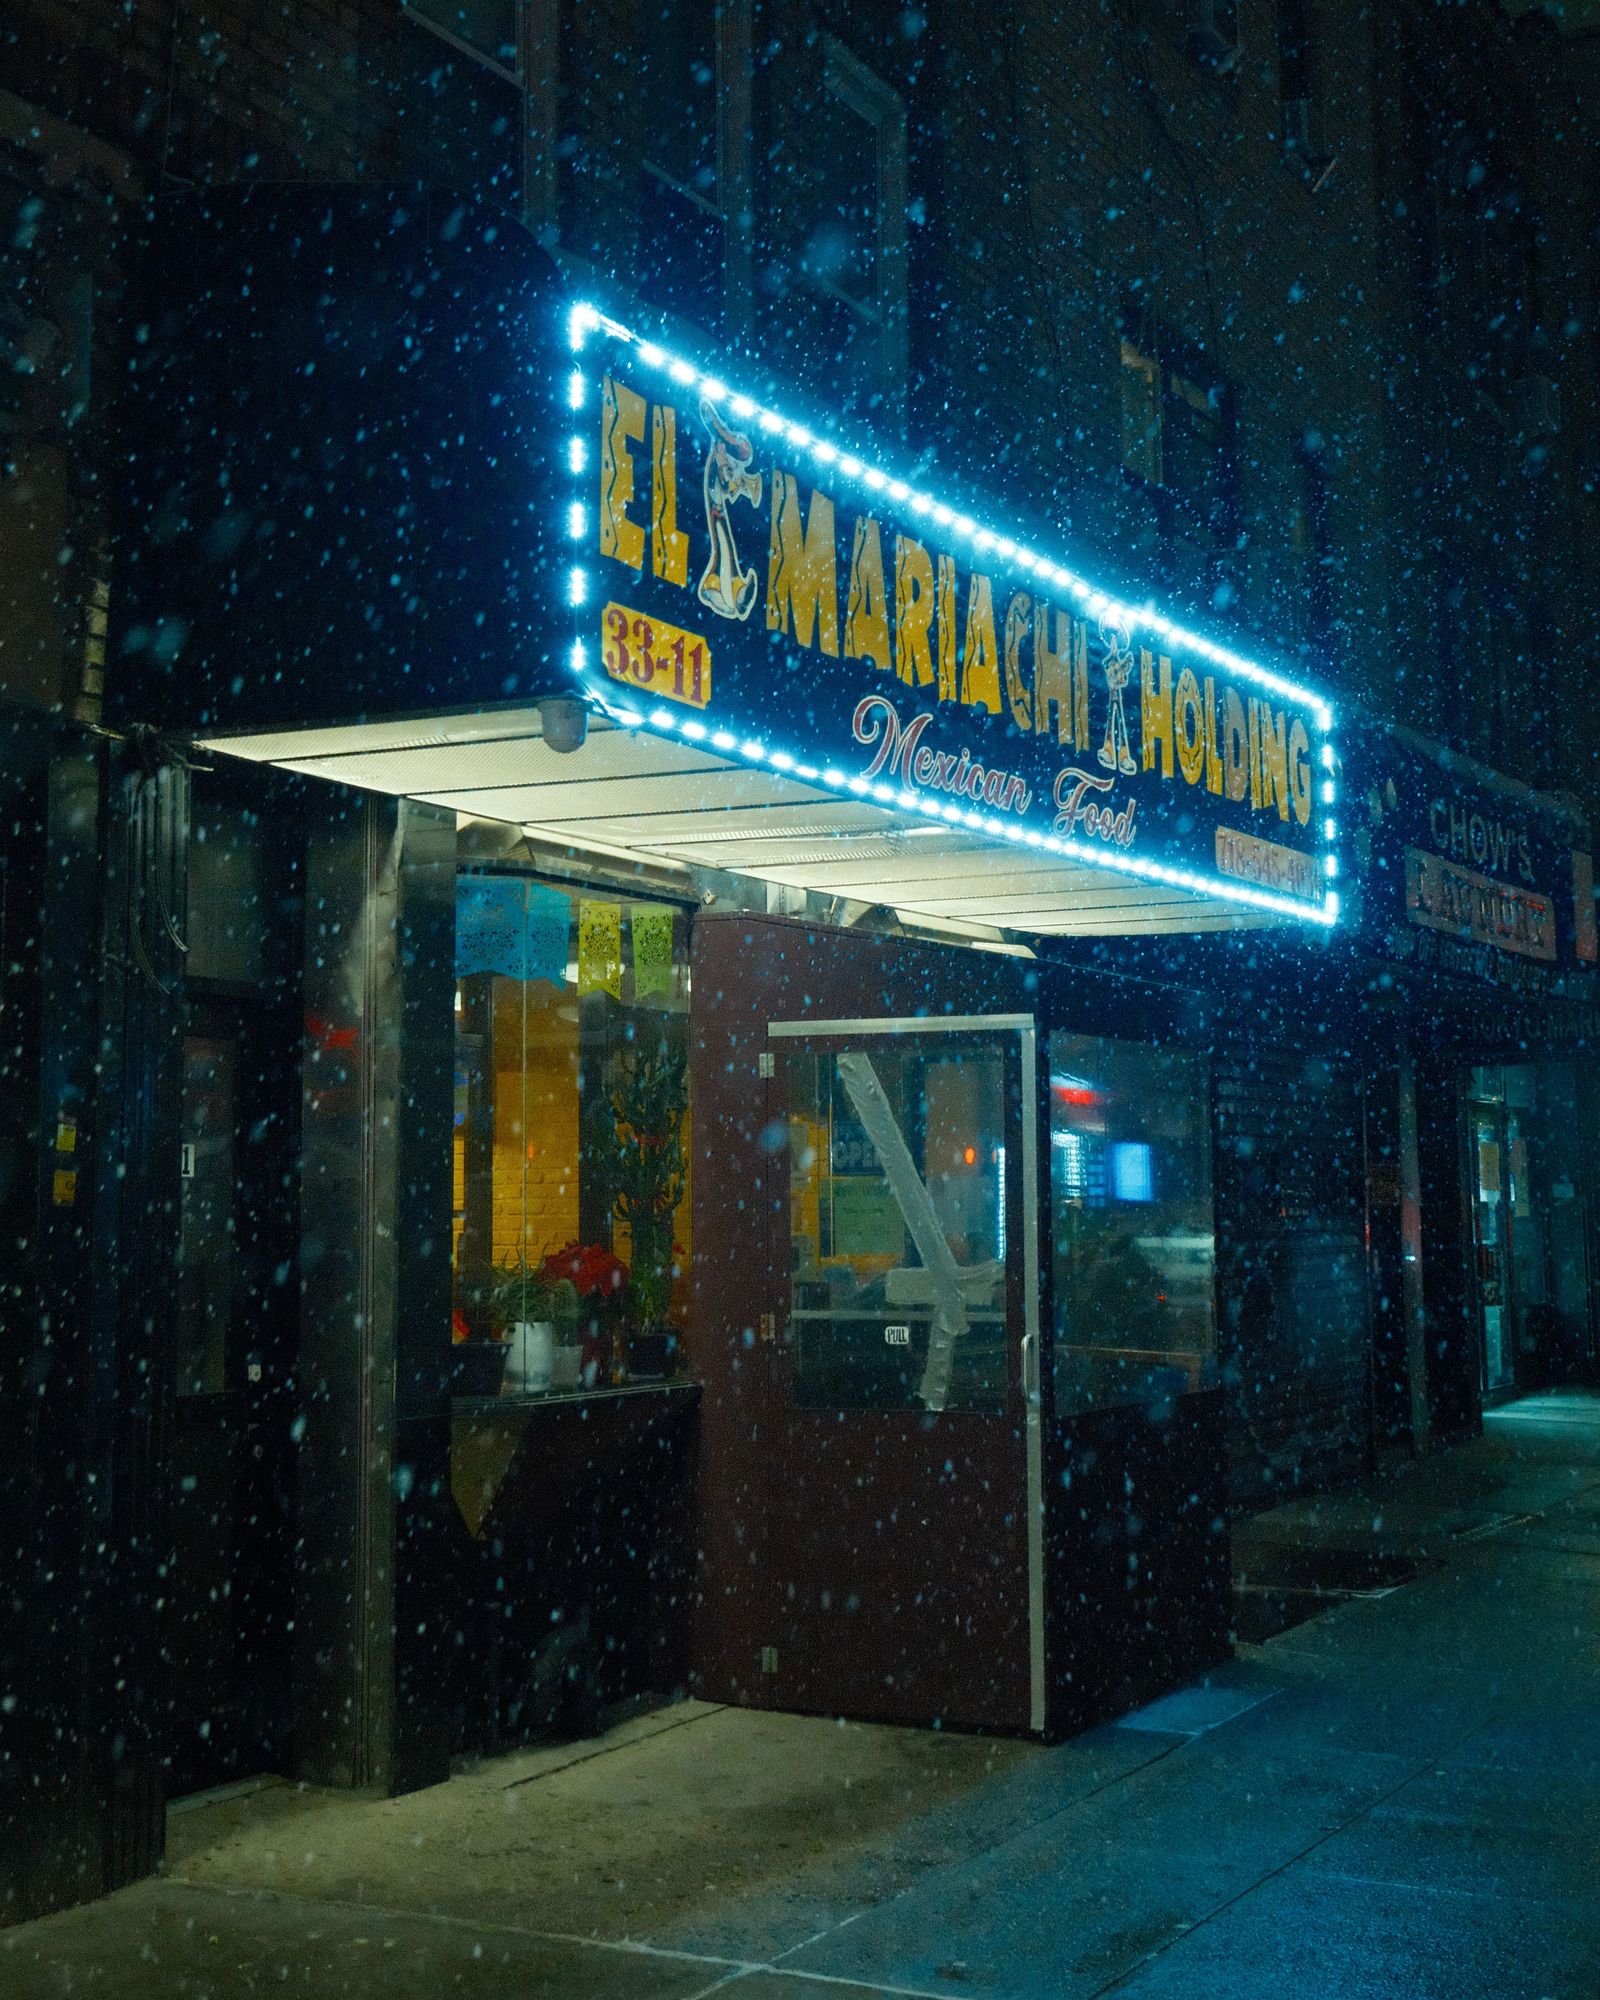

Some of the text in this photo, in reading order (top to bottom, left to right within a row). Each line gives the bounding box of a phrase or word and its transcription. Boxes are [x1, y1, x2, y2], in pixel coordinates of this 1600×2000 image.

[600, 375, 1311, 825] EL MARIACHI HOLDING
[606, 608, 705, 704] 33-11
[852, 695, 1137, 847] Mexican Food
[887, 1328, 907, 1343] PULL
